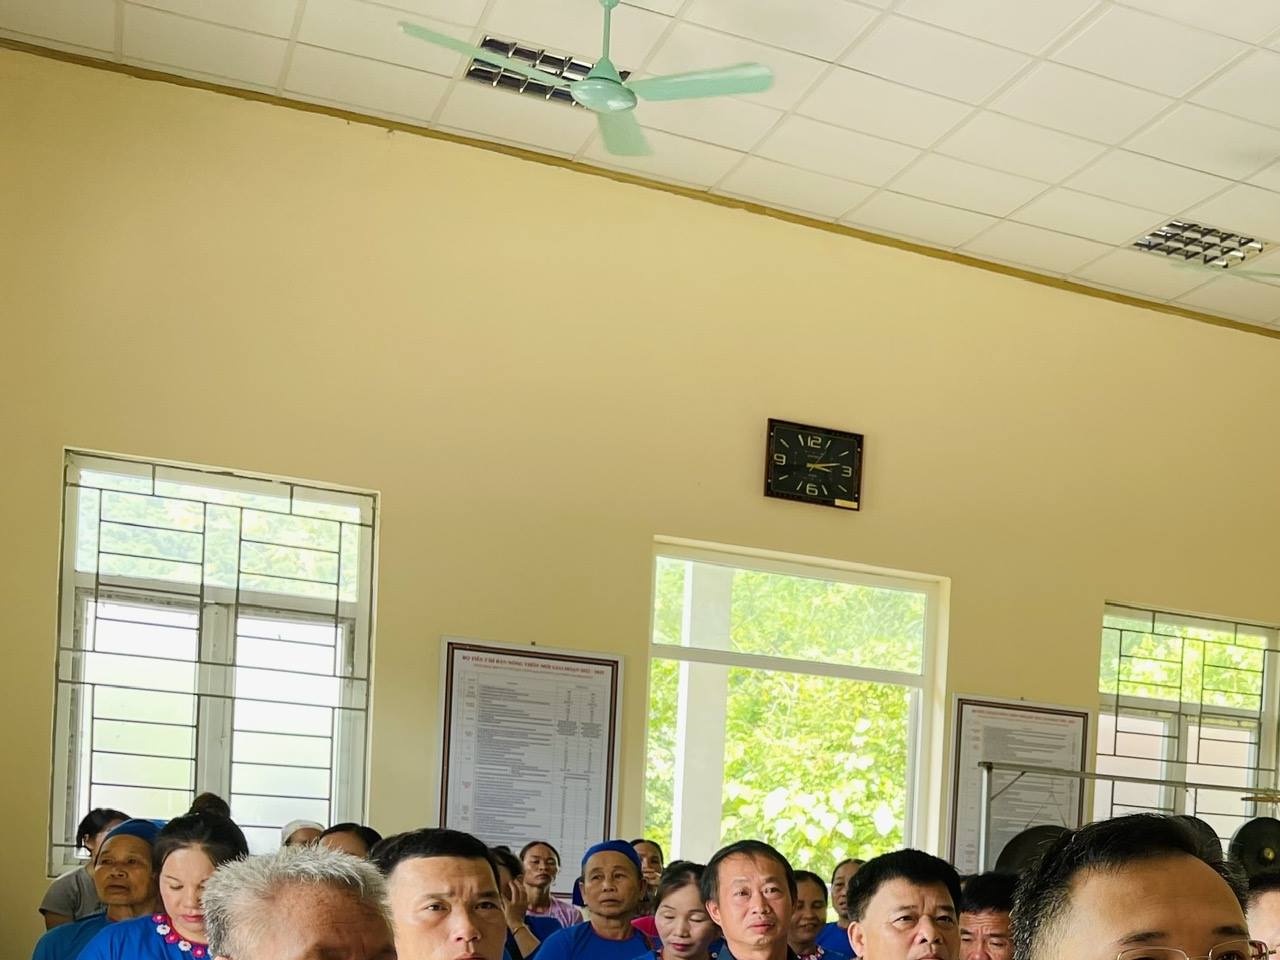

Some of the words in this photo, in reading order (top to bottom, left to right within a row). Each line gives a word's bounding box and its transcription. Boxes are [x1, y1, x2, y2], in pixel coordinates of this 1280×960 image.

[807, 435, 822, 449] 12
[773, 453, 786, 466] 9
[841, 465, 852, 478] 3
[806, 483, 818, 496] 6
